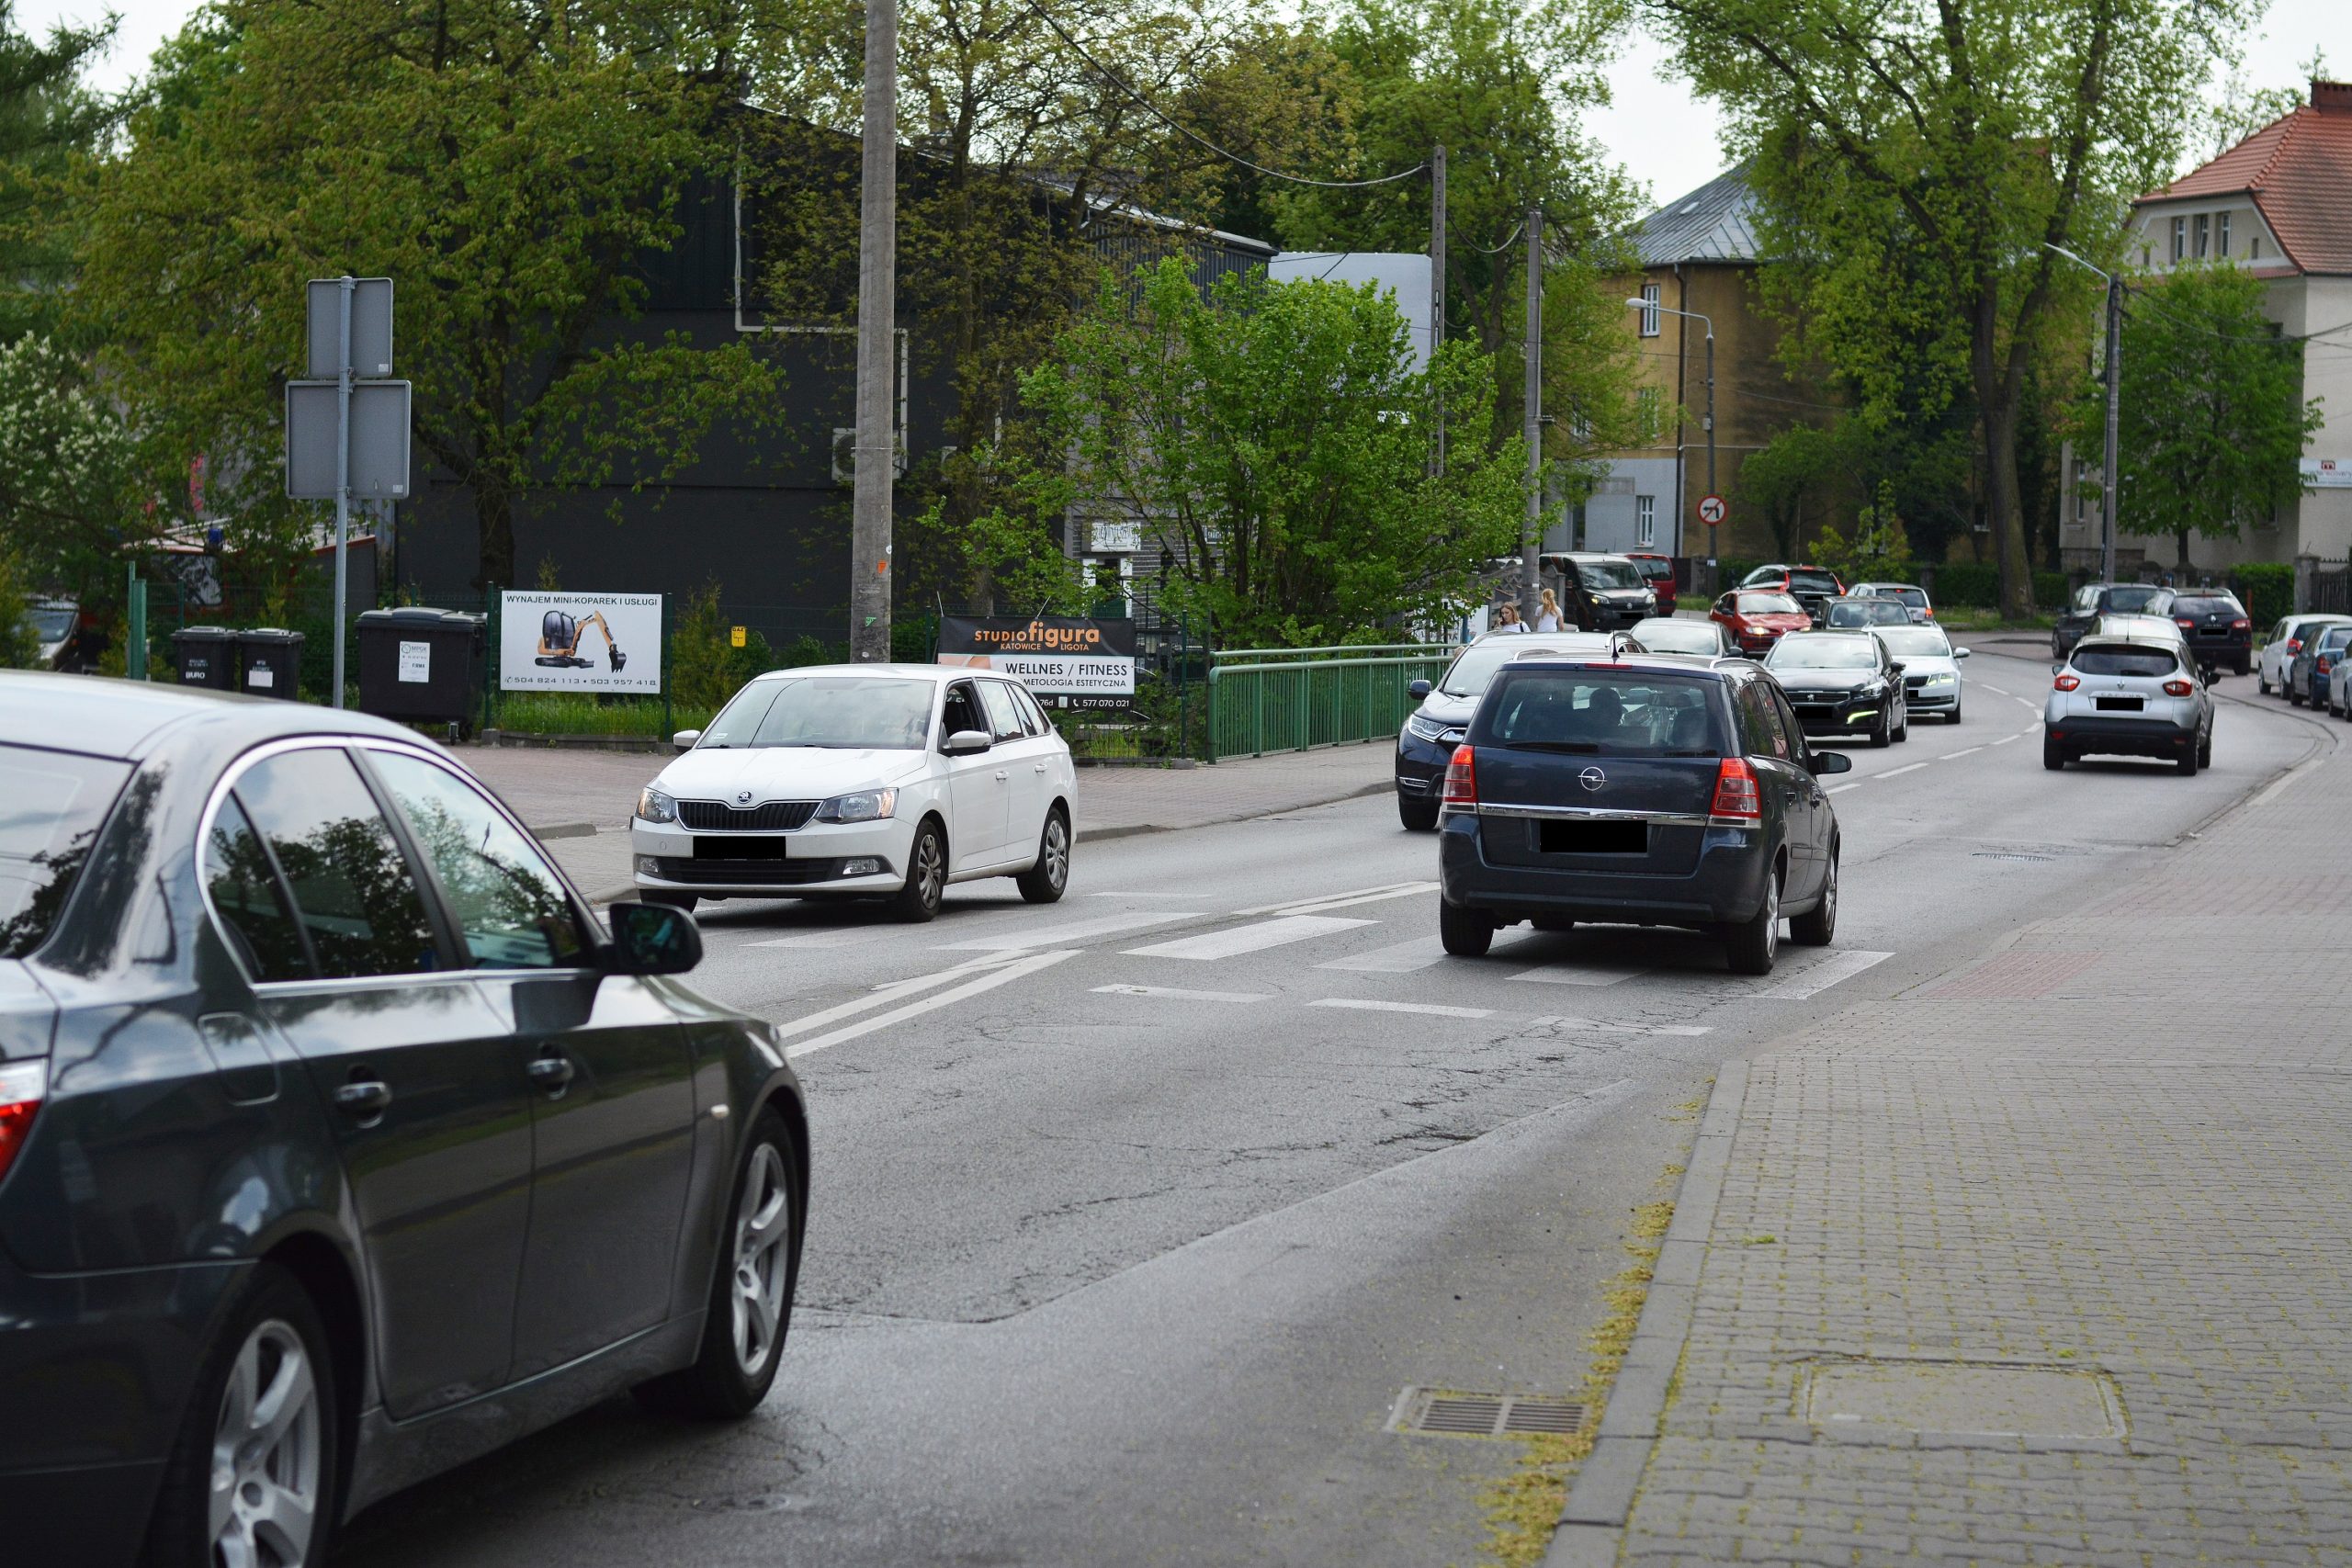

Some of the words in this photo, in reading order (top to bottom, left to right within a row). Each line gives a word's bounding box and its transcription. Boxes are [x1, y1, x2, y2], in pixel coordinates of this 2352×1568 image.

[506, 595, 551, 604] WYNAJEM
[553, 596, 617, 605] MINI-KOPAREK
[625, 598, 657, 606] USŁUGI
[974, 630, 1027, 642] STUDIO
[1028, 621, 1100, 648] figura
[1000, 642, 1041, 650] KATOWICE
[1060, 643, 1090, 651] LIGOTA
[1005, 663, 1063, 675] WELLNES
[1079, 664, 1127, 676] FITNESS
[1022, 678, 1074, 686] METOLOGIA
[1082, 699, 1097, 707] 577
[1098, 699, 1114, 707] 070
[1115, 699, 1129, 707] 021
